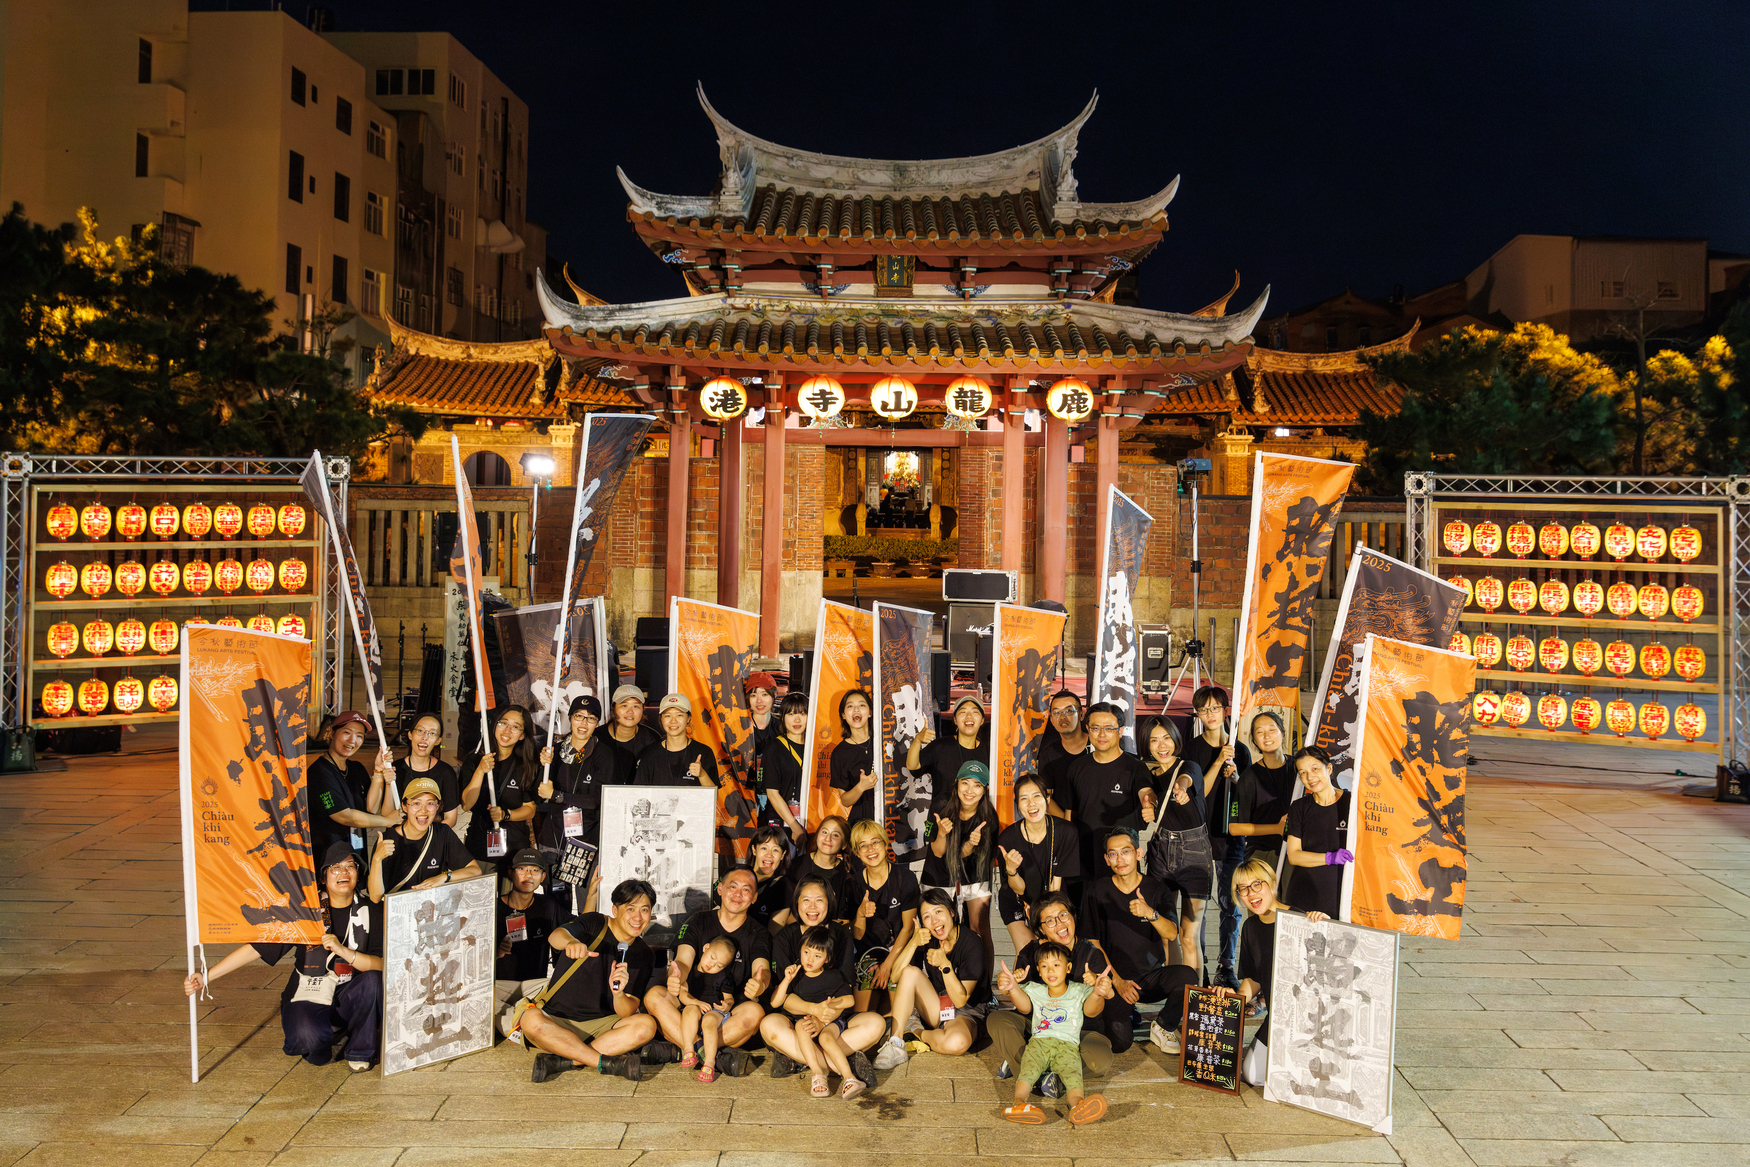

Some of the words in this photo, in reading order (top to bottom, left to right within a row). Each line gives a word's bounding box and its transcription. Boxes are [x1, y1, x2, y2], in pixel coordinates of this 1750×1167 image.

[708, 388, 742, 413] 港
[805, 388, 840, 412] 寺
[880, 390, 914, 413] 山
[954, 387, 987, 413] 龍
[1057, 388, 1090, 414] 鹿
[591, 417, 608, 426] 025
[1639, 529, 1662, 557] 文化部
[1361, 553, 1393, 573] 2025
[880, 608, 896, 619] 2025
[198, 636, 259, 650] 今秋藝術節
[1401, 659, 1424, 669] FESTIVAL
[1364, 791, 1381, 799] 2025
[1364, 801, 1395, 814] Chiàu
[201, 810, 235, 821] Chiàu
[1364, 822, 1389, 836] kang
[203, 834, 231, 846] kang
